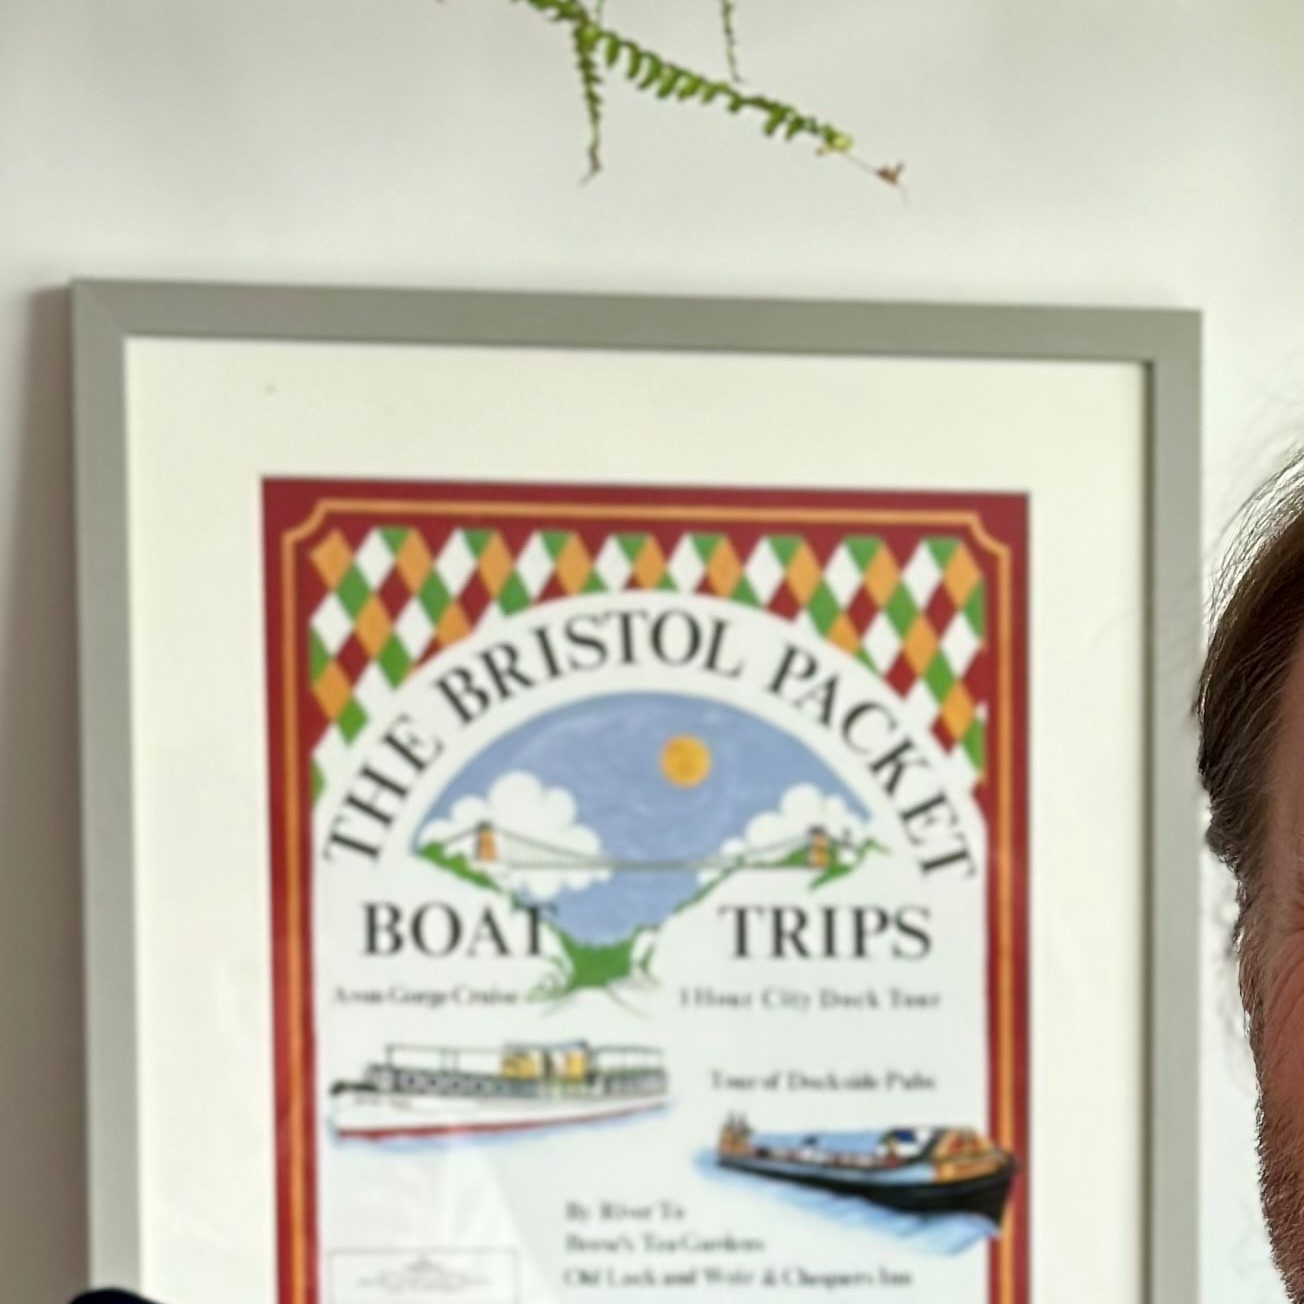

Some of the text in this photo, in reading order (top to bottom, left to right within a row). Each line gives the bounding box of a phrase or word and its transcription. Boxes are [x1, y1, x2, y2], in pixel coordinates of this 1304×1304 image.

[324, 609, 976, 880] THE BRISTOL PACKET
[361, 901, 933, 961] BOAT TRIPS
[760, 988, 812, 1012] City
[819, 988, 880, 1009] Dock
[889, 987, 941, 1009] Tour
